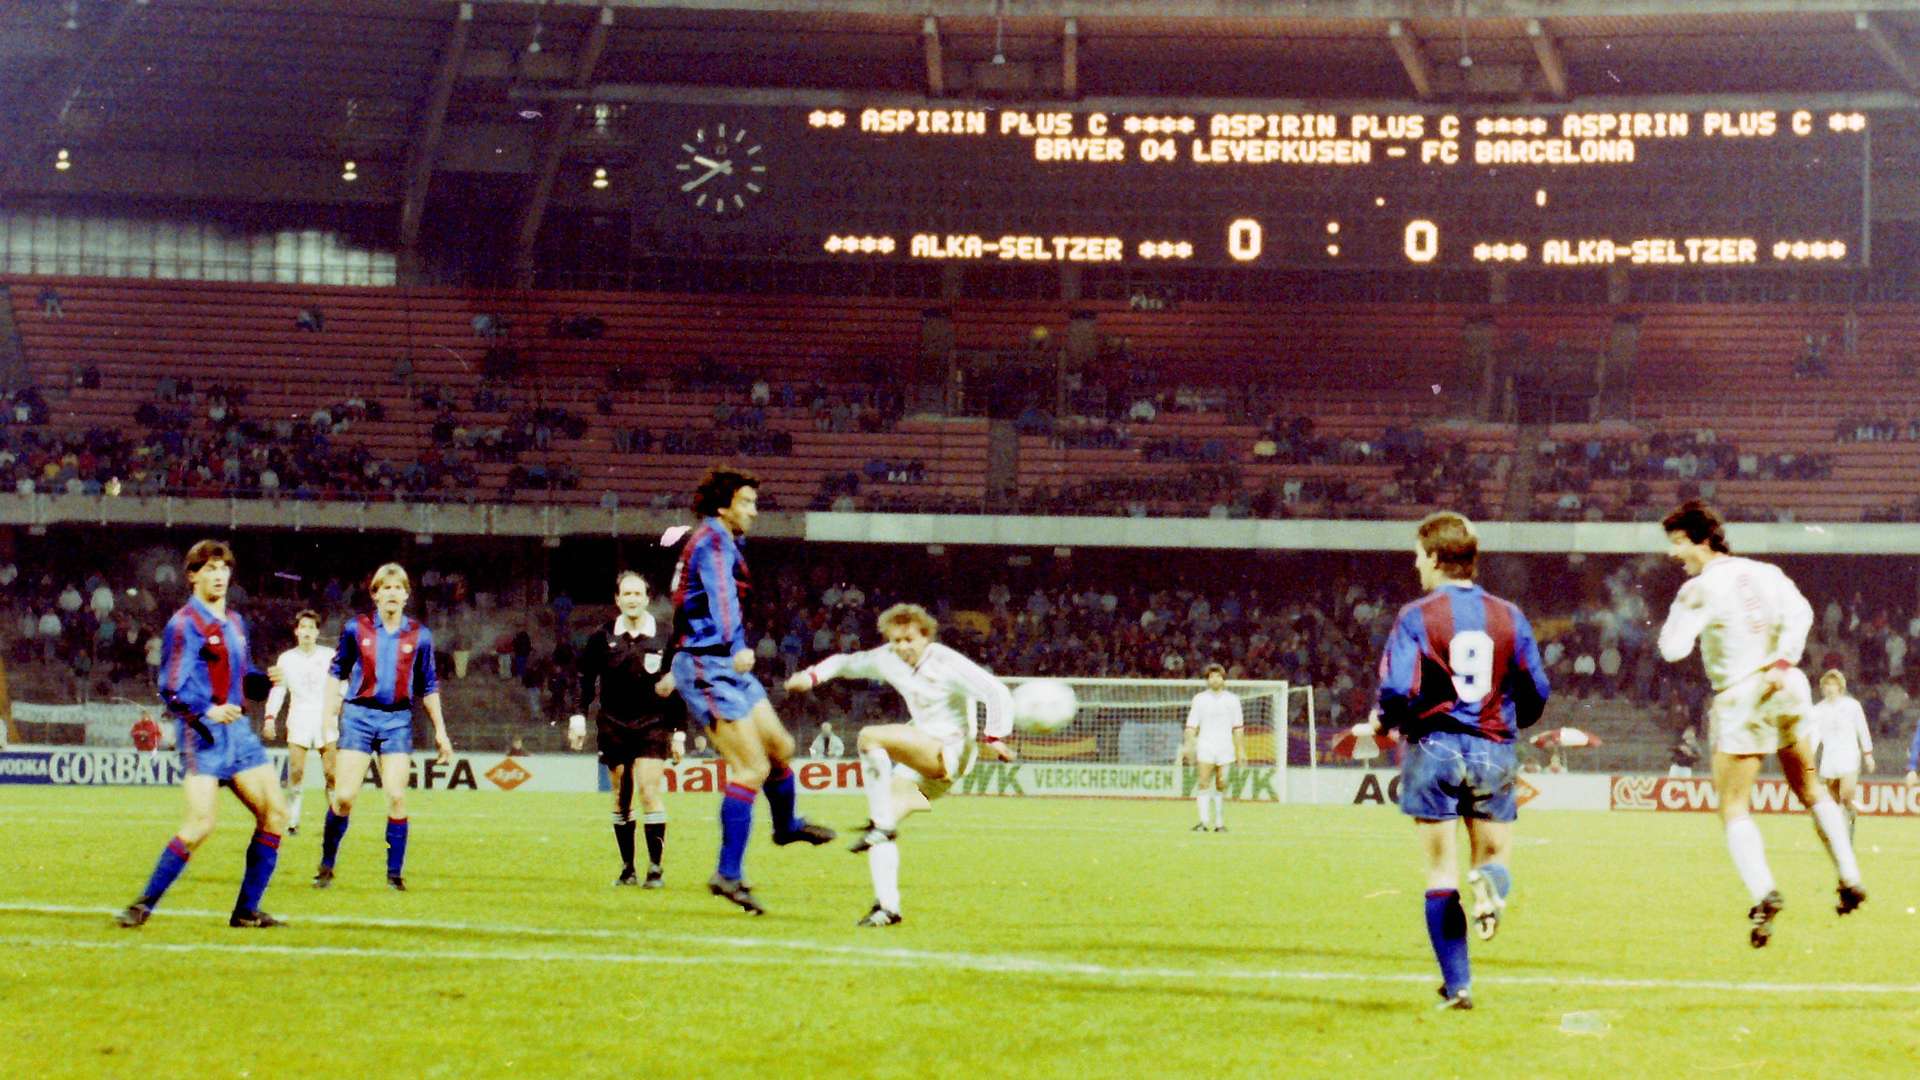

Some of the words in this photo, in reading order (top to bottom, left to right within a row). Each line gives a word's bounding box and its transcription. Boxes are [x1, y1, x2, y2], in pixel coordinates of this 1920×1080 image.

[861, 109, 986, 134] ASPIRIN
[1000, 111, 1073, 136] PLUS
[1088, 113, 1108, 136] C
[1210, 113, 1337, 138] ASPIRIN
[1351, 114, 1424, 139] PLUS
[1439, 115, 1460, 138] C
[1562, 112, 1689, 138] ASPIRIN
[1703, 110, 1777, 137] PLUS
[1791, 110, 1812, 135] C
[1035, 137, 1125, 161] BAYER
[1140, 138, 1177, 162] 04
[1192, 139, 1371, 164] LEVERKUSEN
[1421, 140, 1459, 164] FC
[1474, 138, 1635, 164] BARCELONA
[911, 234, 1122, 261] ALKA-SELTZER
[1228, 218, 1262, 261] 0
[1404, 220, 1438, 262] 0
[1542, 238, 1758, 265] ALKA-SELTZER
[1449, 630, 1494, 703] 9
[1034, 767, 1173, 790] VERSICHERUNGEN
